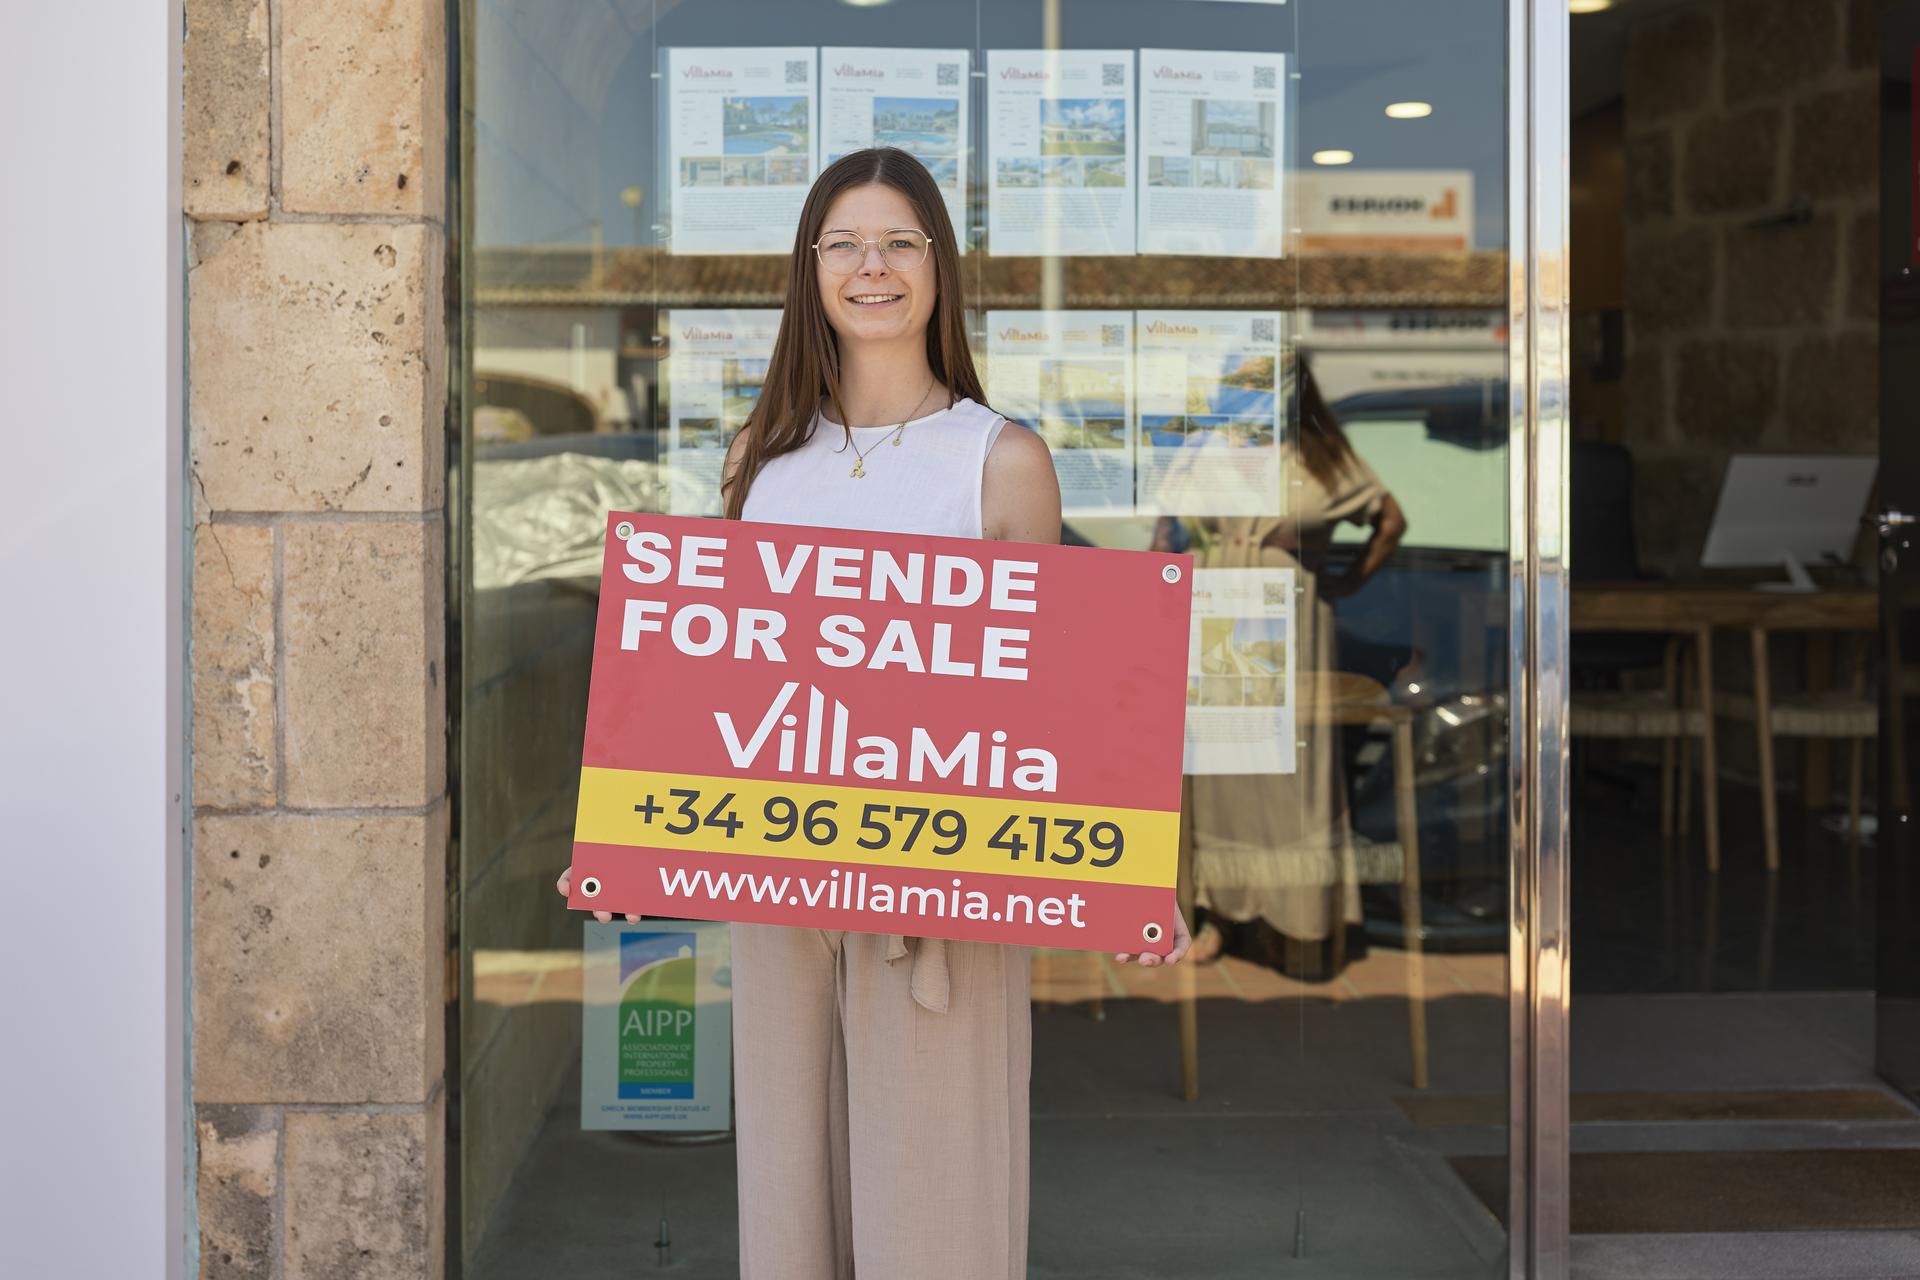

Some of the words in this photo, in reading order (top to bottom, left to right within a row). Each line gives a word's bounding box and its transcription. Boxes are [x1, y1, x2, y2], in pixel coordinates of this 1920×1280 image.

[681, 64, 733, 80] VillaMia
[834, 63, 885, 79] VillaMia
[1153, 65, 1202, 81] VillaMia
[682, 326, 733, 342] VillaMia
[1146, 320, 1199, 336] VillaMia
[621, 531, 728, 589] SE
[755, 541, 1039, 613] VENDE
[620, 599, 788, 663] FOR
[815, 614, 1030, 681] SALE
[713, 682, 1058, 793] VillaMia
[634, 788, 744, 838] +34
[763, 796, 838, 845] 96
[856, 803, 967, 855] 579
[987, 814, 1124, 868] 4139
[658, 867, 1086, 928] www.villamia.net
[622, 1009, 692, 1036] AIPP
[623, 1043, 678, 1051] ASSOCIATION
[680, 1043, 691, 1051] OF
[636, 1060, 676, 1068] PROPERTY
[624, 1069, 689, 1077] PROFESSIONALS
